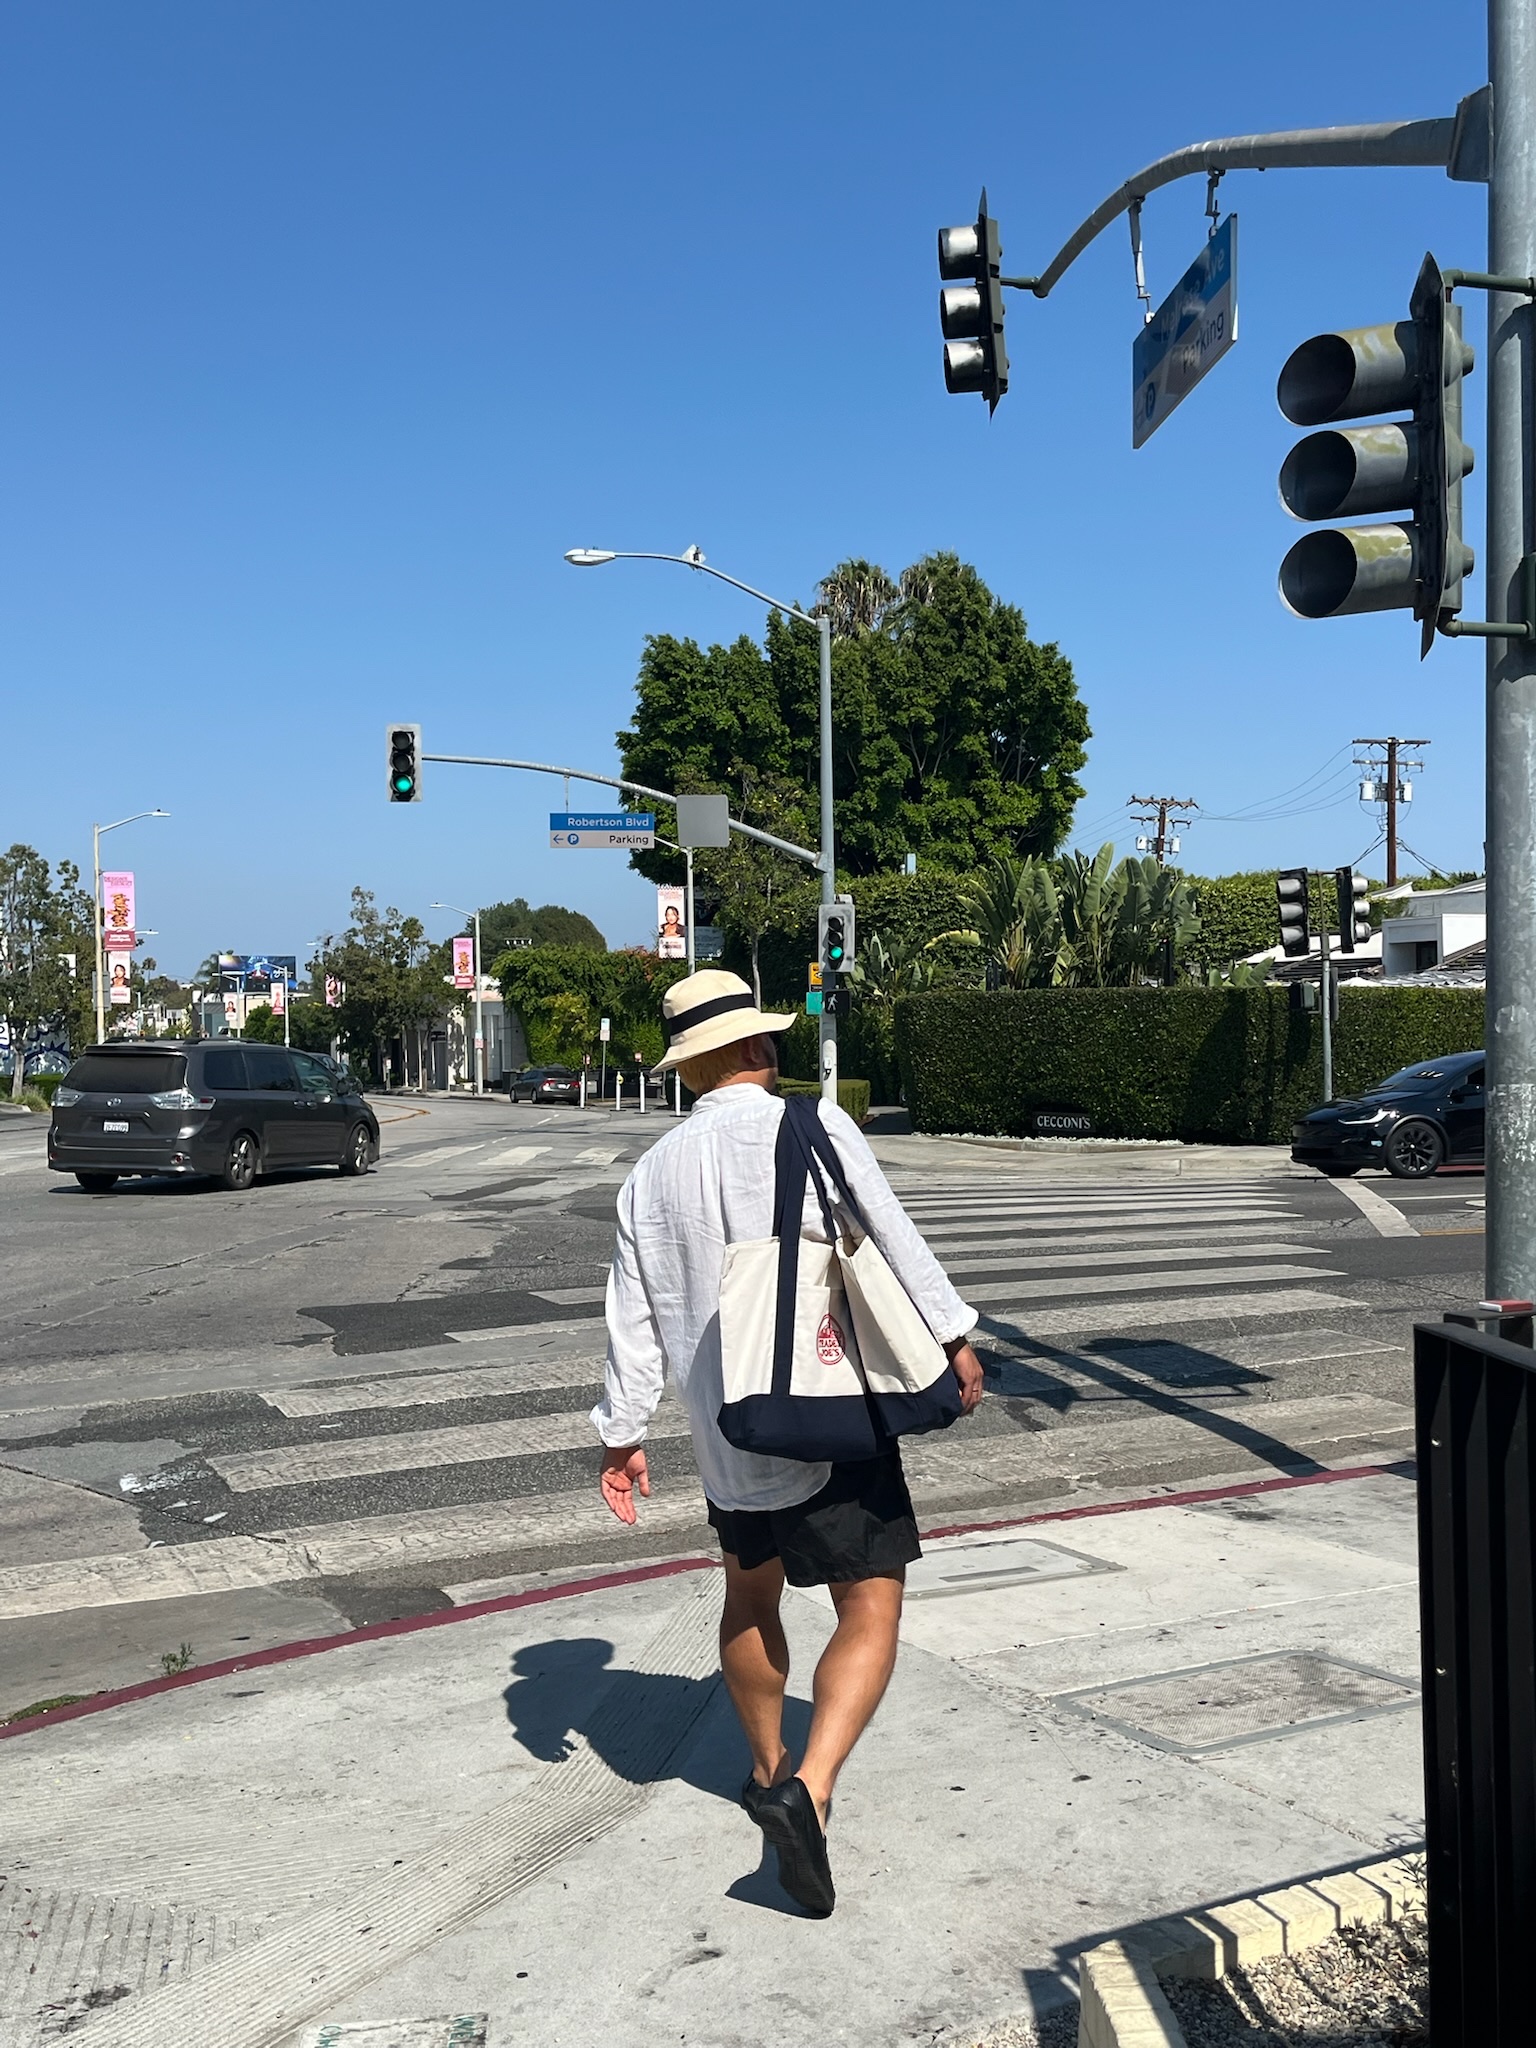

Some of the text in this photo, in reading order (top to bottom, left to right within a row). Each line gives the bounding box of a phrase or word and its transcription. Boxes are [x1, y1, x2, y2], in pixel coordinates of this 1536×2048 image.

[1160, 249, 1224, 344] Melre Ave
[1182, 311, 1224, 374] Parking
[567, 817, 649, 827] Robertson Blvd
[609, 835, 649, 845] Parking
[1037, 1115, 1091, 1129] CECCONI'S
[819, 1339, 840, 1348] TRADE
[820, 1349, 839, 1357] JOE'S
